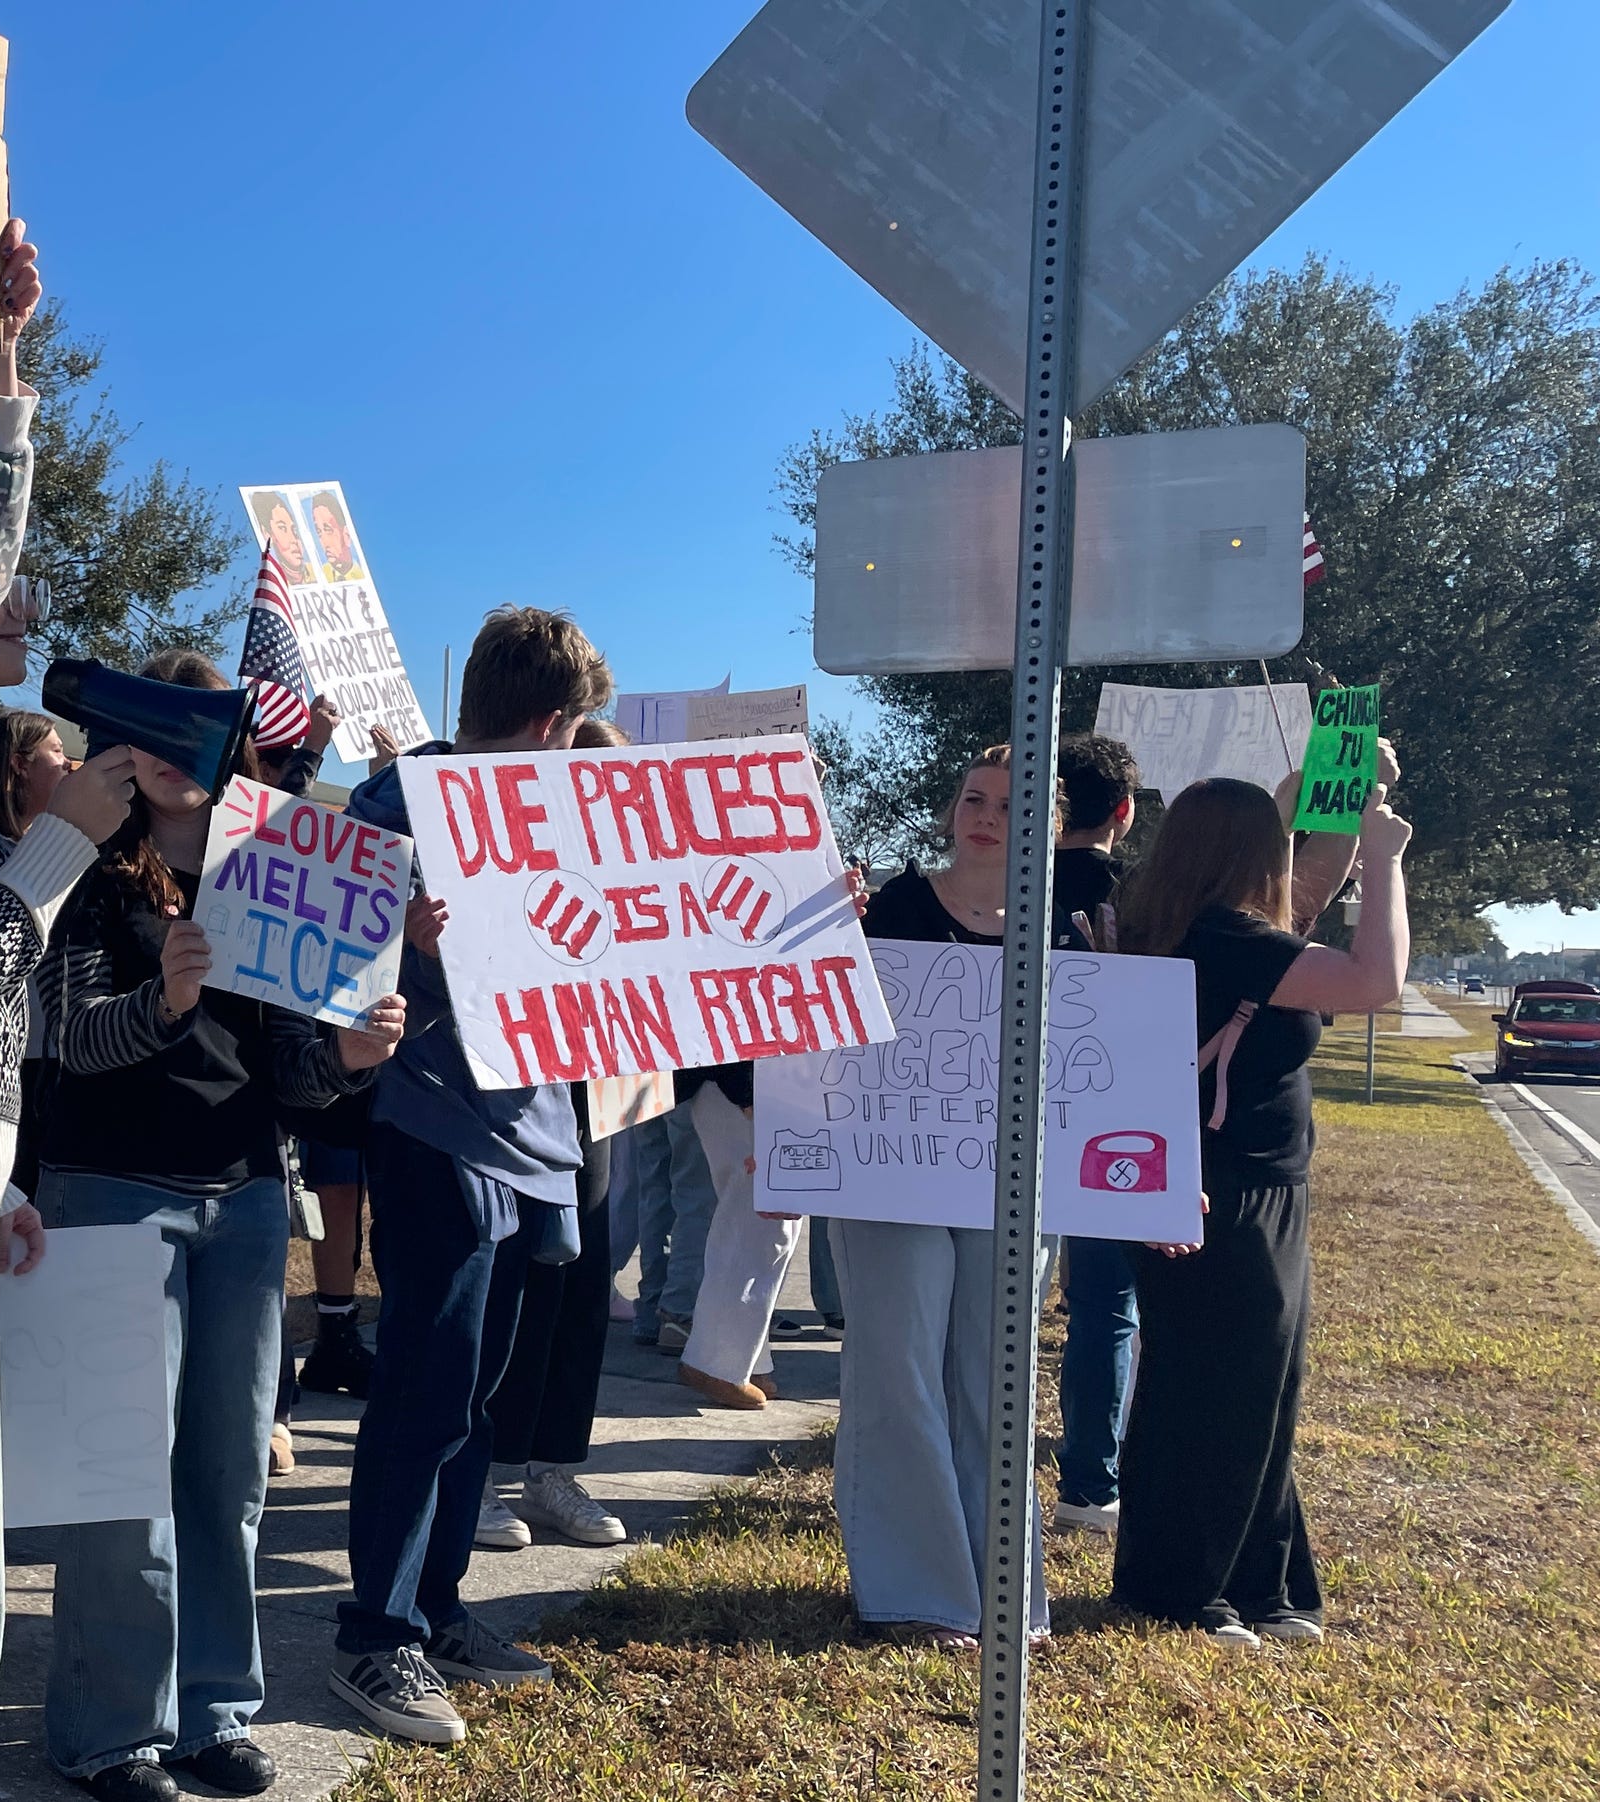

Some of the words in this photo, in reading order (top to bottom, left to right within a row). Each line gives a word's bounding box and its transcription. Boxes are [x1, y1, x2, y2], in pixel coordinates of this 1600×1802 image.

[300, 627, 403, 684] HARRIETTE
[373, 674, 416, 709] WANT
[1336, 730, 1364, 768] TU
[254, 791, 380, 879] LOVE
[437, 764, 558, 878] DUE
[568, 750, 822, 866] PROCESS
[214, 848, 399, 944] MELTS
[603, 884, 669, 943] IS
[680, 882, 713, 938] A
[236, 908, 379, 1021] ICE
[868, 944, 1101, 1029] SAE
[495, 975, 684, 1087] HUMAN
[690, 956, 868, 1064] RIGHT
[824, 1090, 1072, 1129] DIFFERT
[782, 1146, 824, 1157] POLICE
[788, 1157, 826, 1169] ICE
